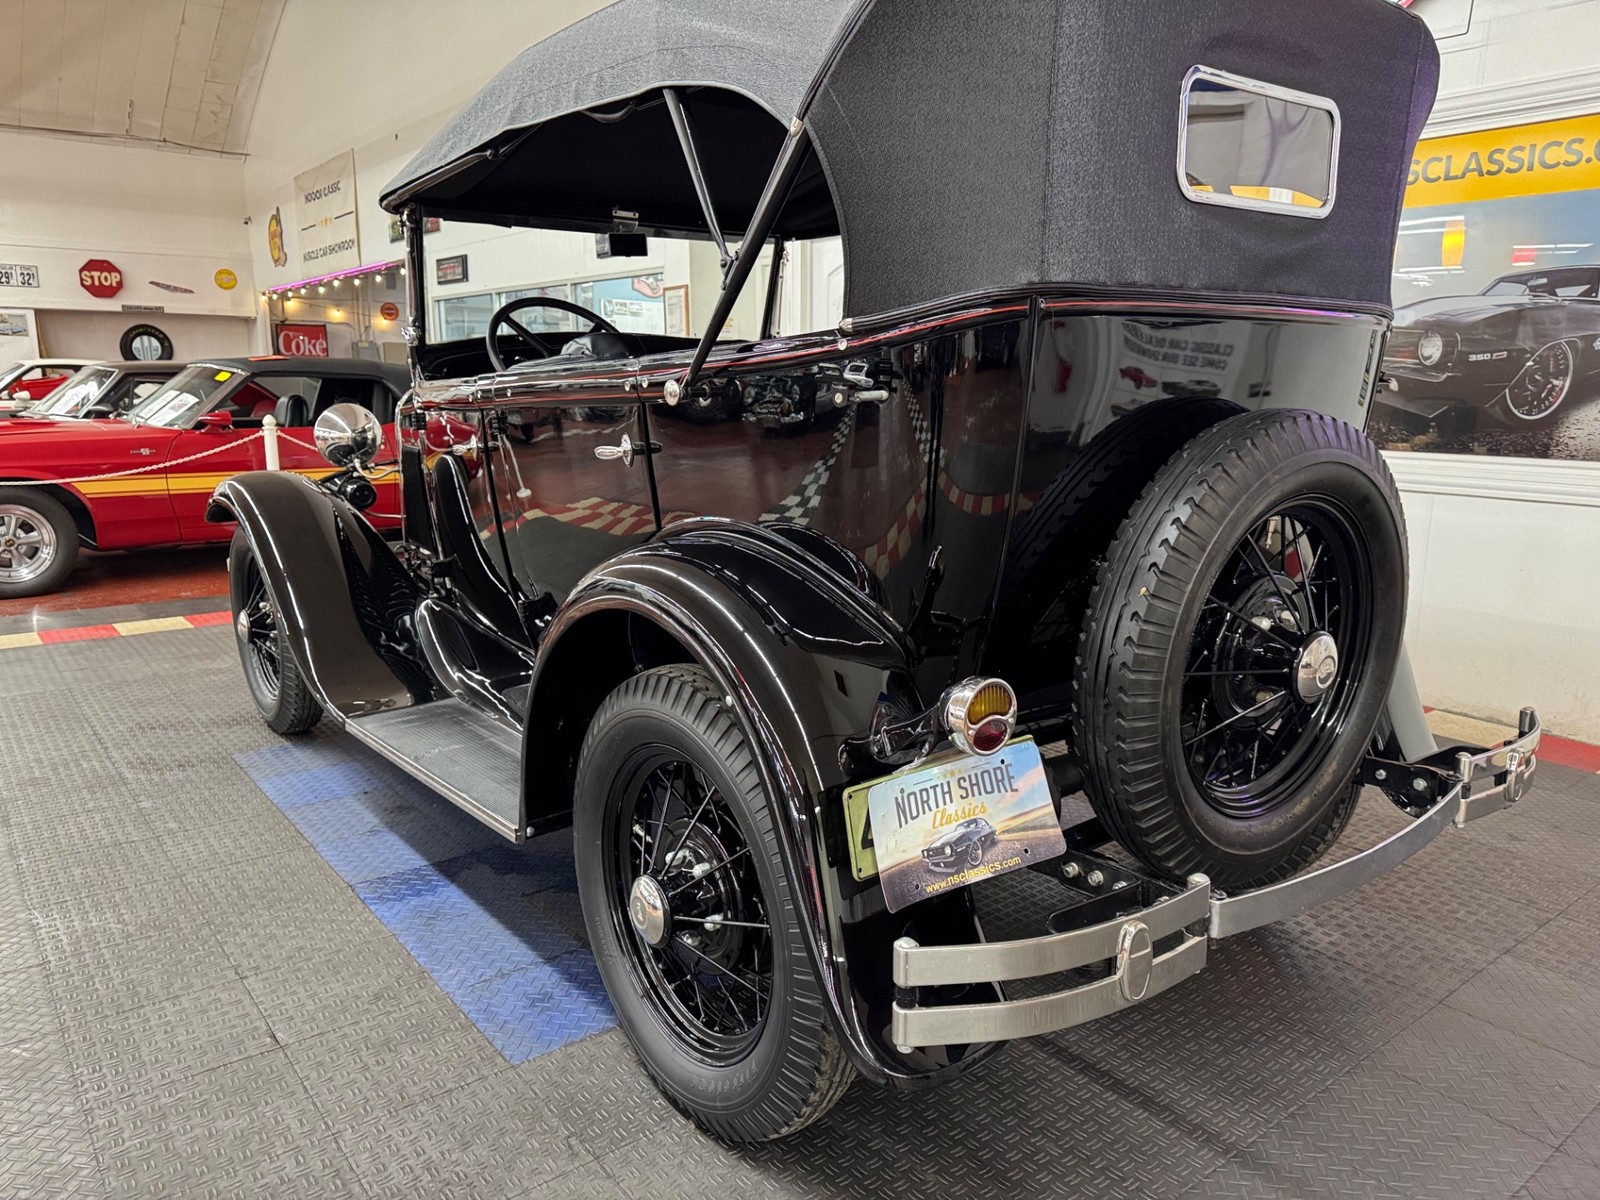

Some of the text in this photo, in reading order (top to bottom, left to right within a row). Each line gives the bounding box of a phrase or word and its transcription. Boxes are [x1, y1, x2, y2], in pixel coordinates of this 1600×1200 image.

[81, 271, 121, 287] STOP
[278, 331, 327, 357] Coke
[1468, 352, 1491, 361] 350
[894, 763, 1018, 829] NORTH SHORE
[932, 800, 988, 830] Classics
[926, 855, 1021, 893] www.nsclassics.com
